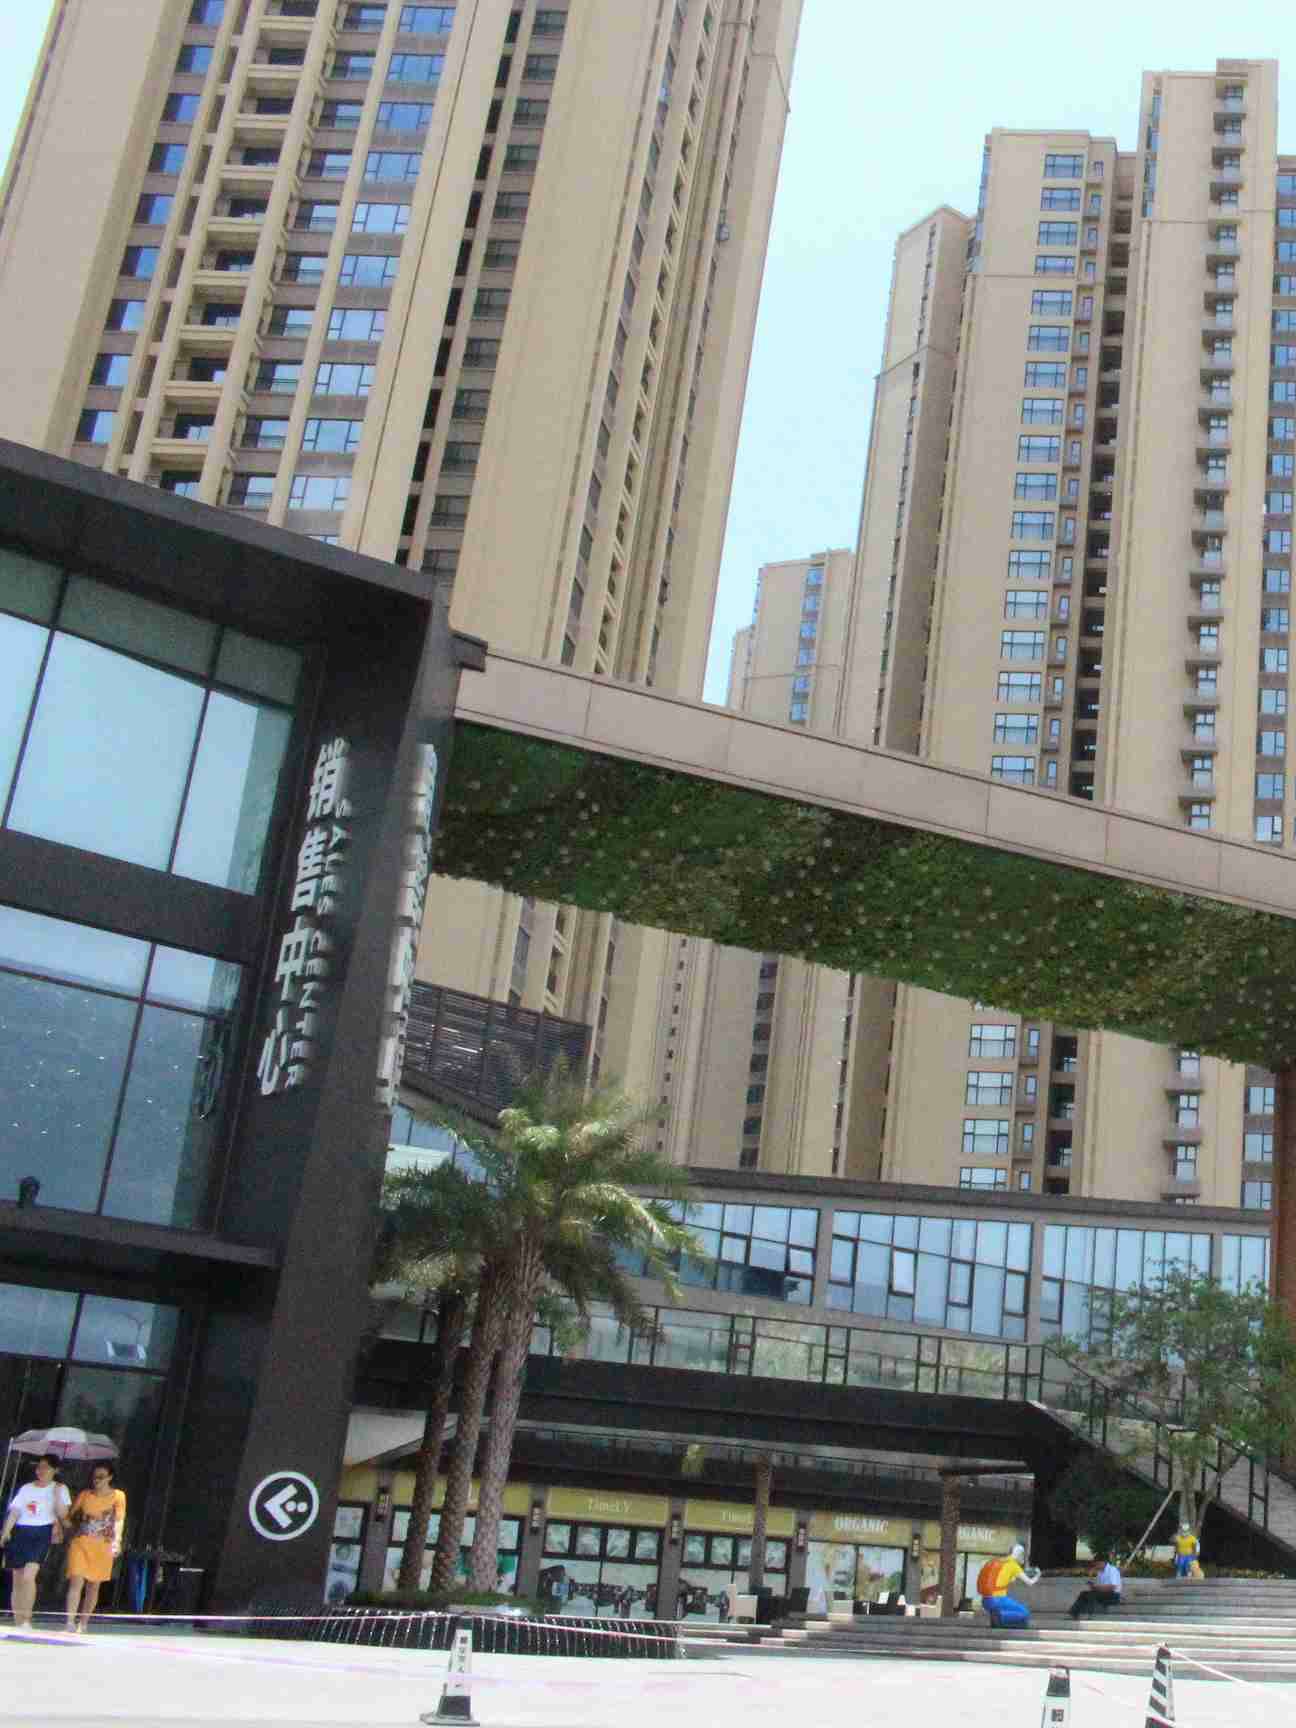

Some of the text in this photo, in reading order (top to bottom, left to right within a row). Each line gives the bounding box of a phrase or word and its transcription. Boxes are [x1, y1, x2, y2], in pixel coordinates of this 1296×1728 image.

[256, 737, 347, 1096] 销售中心
[284, 798, 351, 1090] SALES CENTER
